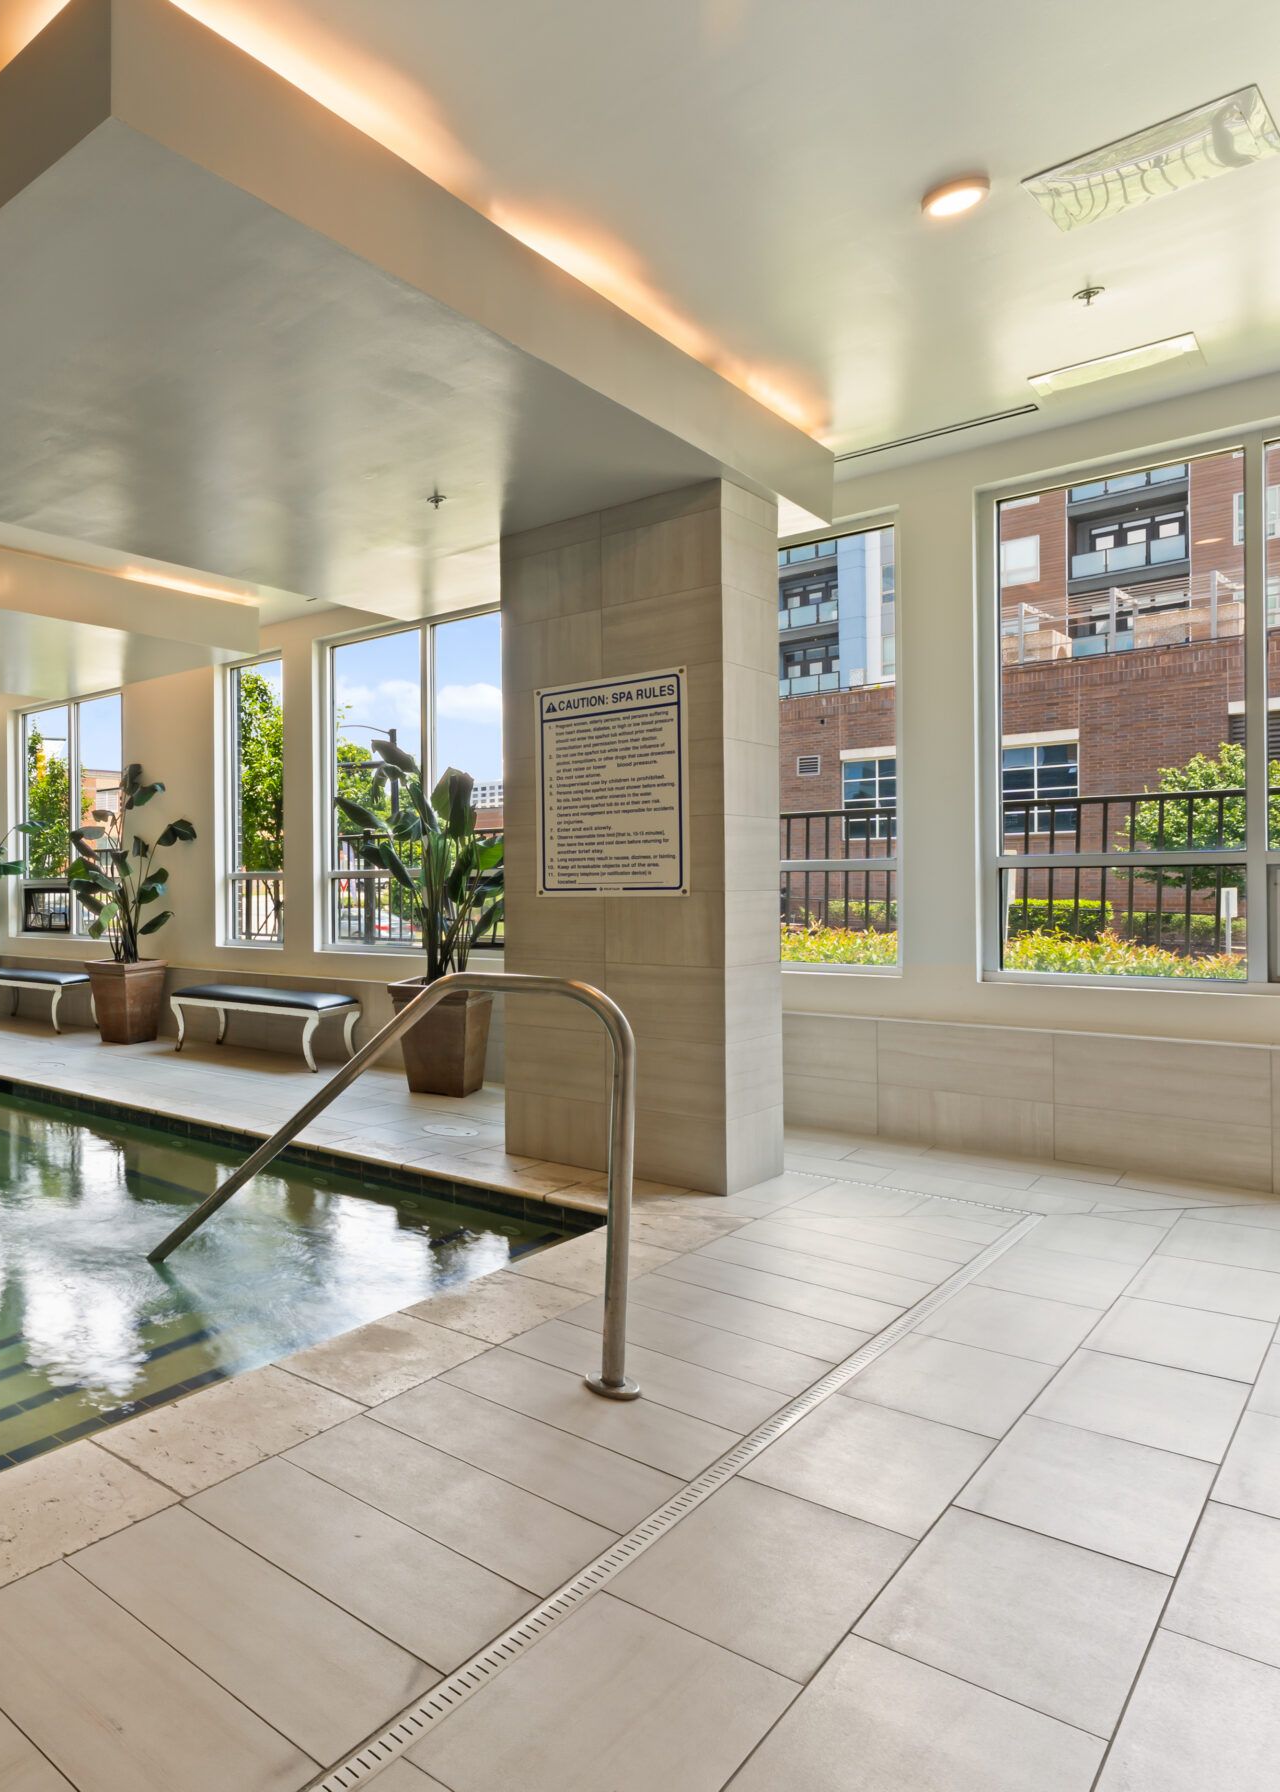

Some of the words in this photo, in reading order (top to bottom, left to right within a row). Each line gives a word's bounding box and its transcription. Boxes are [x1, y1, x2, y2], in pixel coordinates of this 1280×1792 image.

[558, 694, 609, 711] CAUTION:
[611, 690, 633, 704] SPA
[636, 684, 675, 701] RULES
